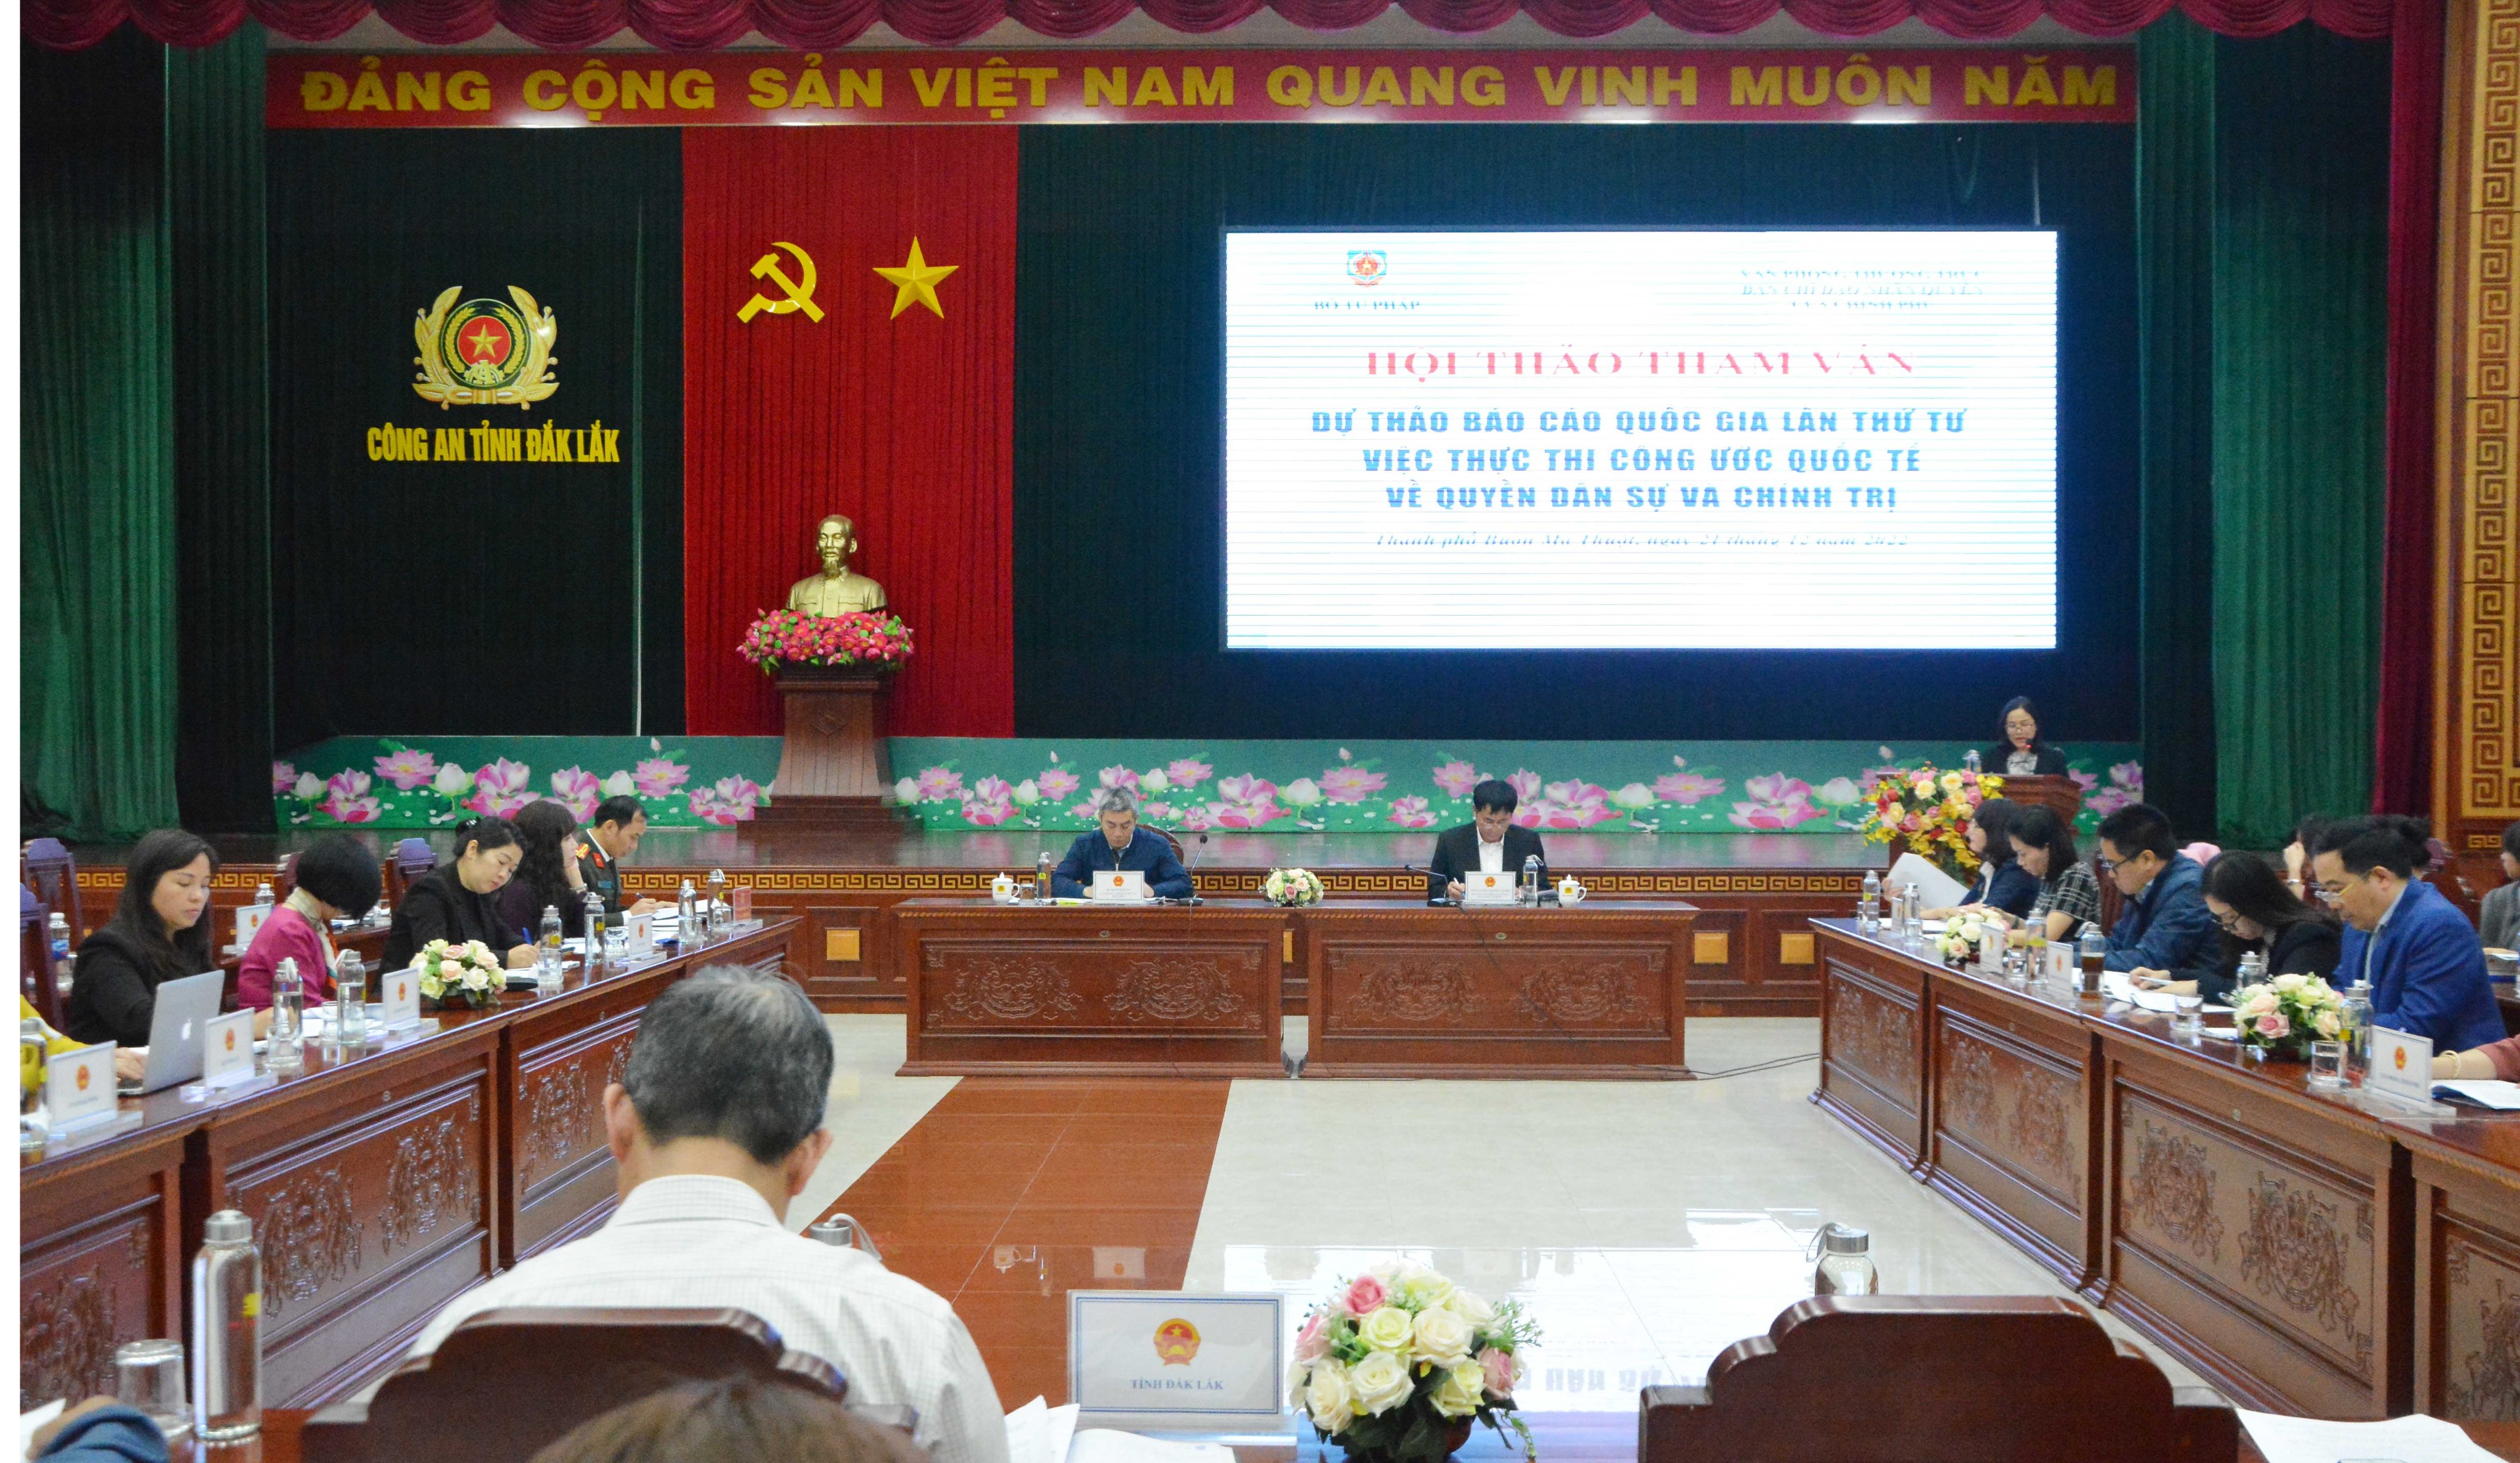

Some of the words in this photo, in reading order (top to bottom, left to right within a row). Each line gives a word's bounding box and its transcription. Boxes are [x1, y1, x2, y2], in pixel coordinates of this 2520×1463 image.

[300, 57, 490, 111] ĐẢNG
[523, 60, 714, 121] CỘNG
[748, 54, 882, 109] SẢN
[910, 57, 1062, 119] VIỆT
[1084, 66, 1233, 107] NAM
[1266, 65, 1505, 108] QUANG
[1534, 66, 1697, 106] VINH
[1730, 54, 1931, 106] MUÔN
[1963, 55, 2117, 106] NĂM
[1638, 352, 1790, 375] THAM
[1312, 408, 1356, 436] DỰ
[1367, 405, 1448, 433] THẢO
[1463, 407, 1524, 433] BÁO
[1540, 407, 1601, 433] CÁO
[1716, 411, 1769, 432] GIA
[1927, 408, 1968, 433] TƯ
[367, 422, 428, 461] CÔNG
[434, 429, 465, 461] AN
[470, 420, 521, 461] TỈNH
[526, 420, 572, 462] ĐẮK
[577, 420, 620, 463] LẮK
[1545, 449, 1594, 471] THI
[1610, 445, 1695, 471] CÔNG
[1386, 479, 1422, 508] VỀ
[1551, 482, 1612, 508] DÂN
[1846, 486, 1897, 512] TRỊ
